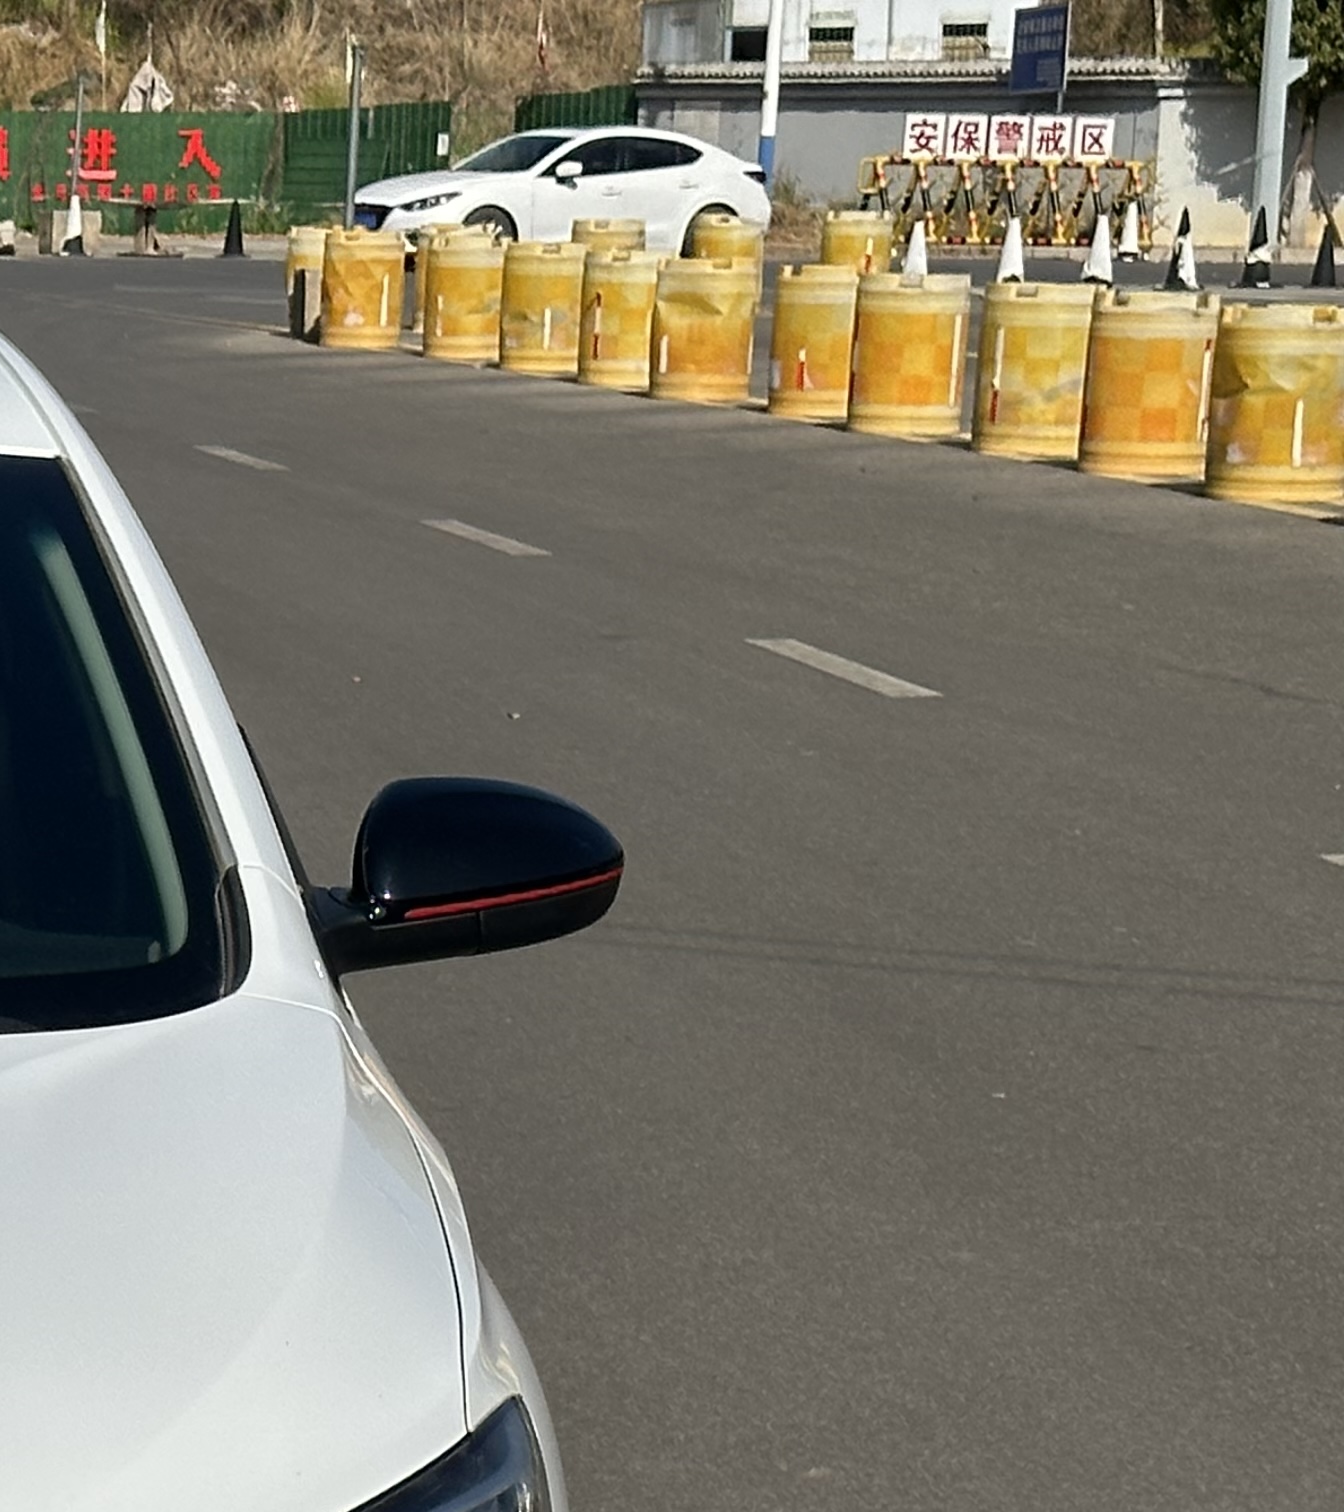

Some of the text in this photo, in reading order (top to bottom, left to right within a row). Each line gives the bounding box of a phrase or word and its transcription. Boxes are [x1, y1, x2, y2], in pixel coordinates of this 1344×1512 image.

[909, 119, 1109, 156] 安保警戒区
